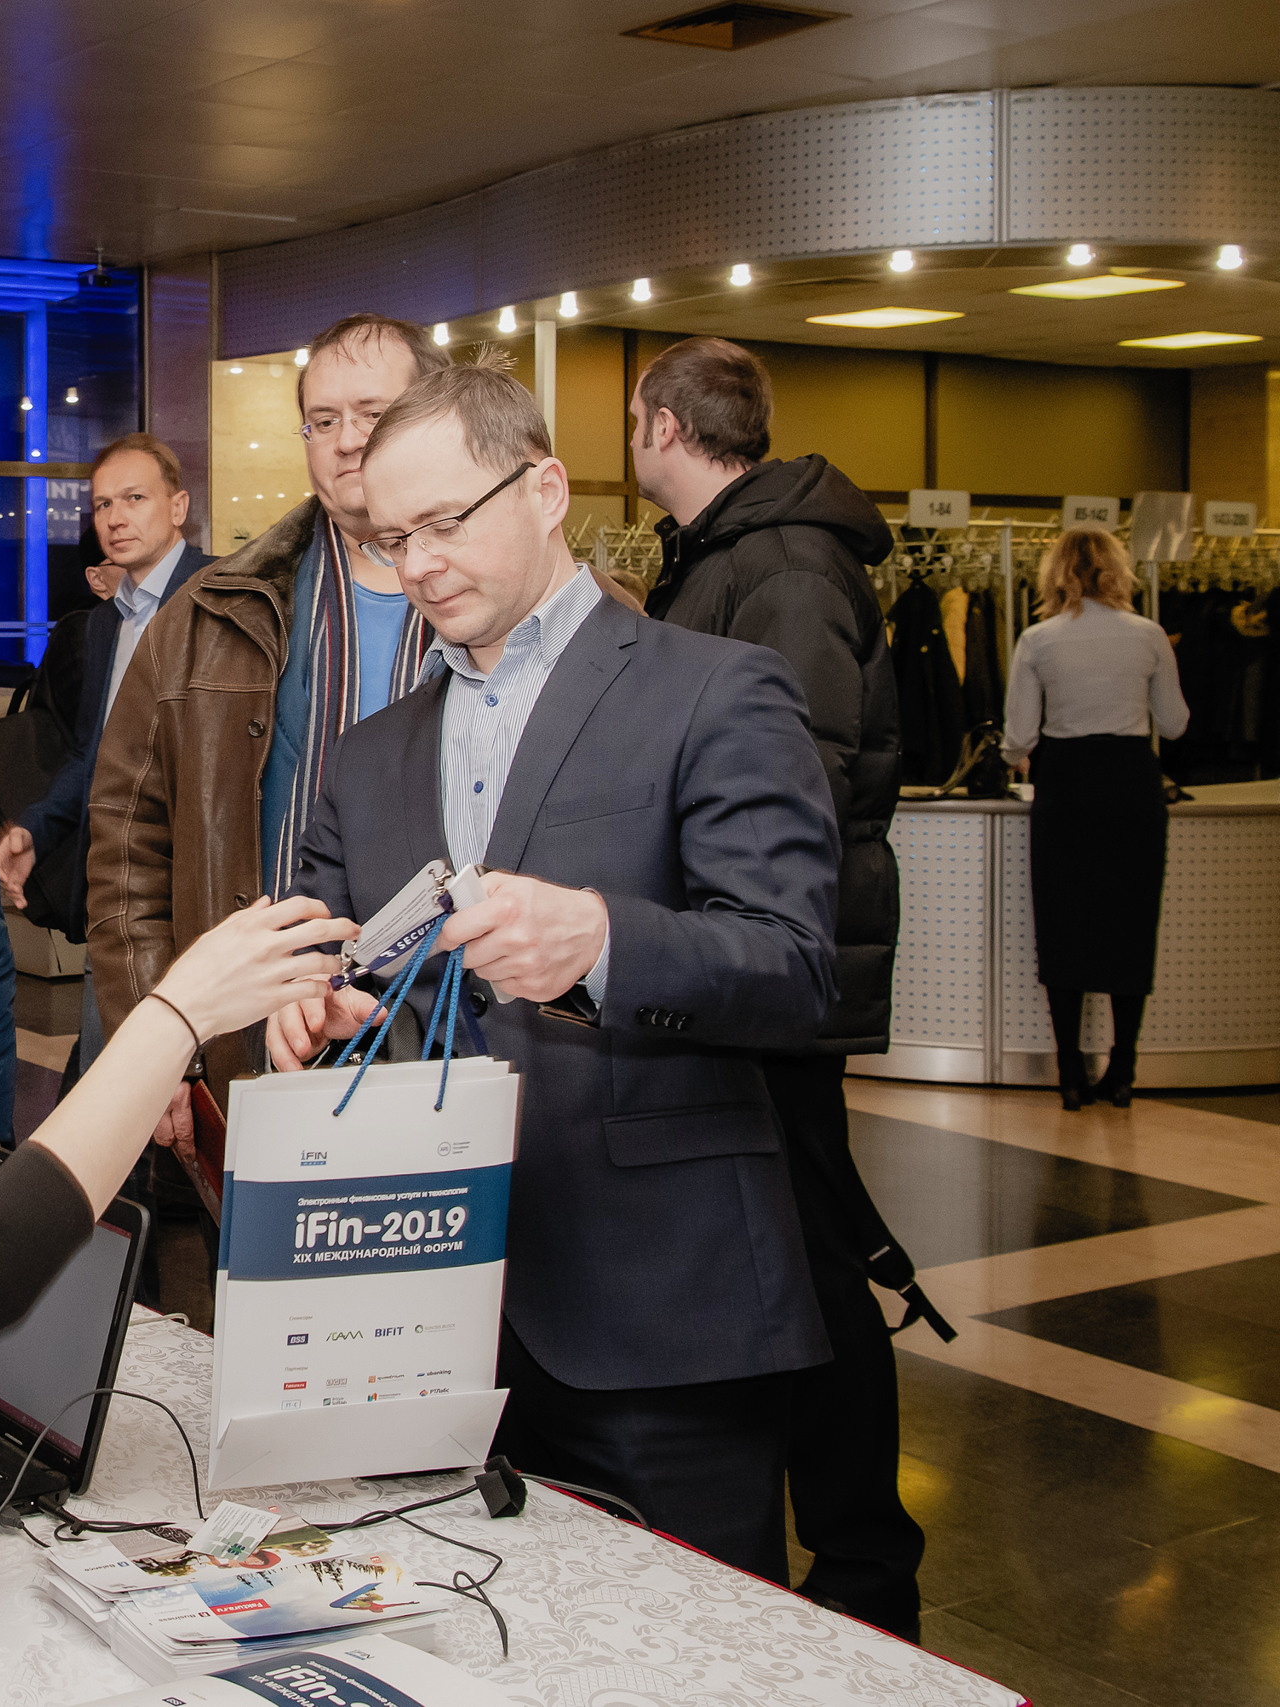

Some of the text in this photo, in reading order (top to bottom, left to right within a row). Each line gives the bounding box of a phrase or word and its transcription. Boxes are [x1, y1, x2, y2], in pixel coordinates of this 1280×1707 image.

[396, 920, 436, 950] SECUR
[295, 1206, 467, 1249] iFin-2019
[293, 1240, 463, 1264] XIX МЕЖДУНАРОДНЫЙ ФОРУМ
[374, 1326, 404, 1338] BIFIT
[216, 1601, 264, 1614] Faktura.ru
